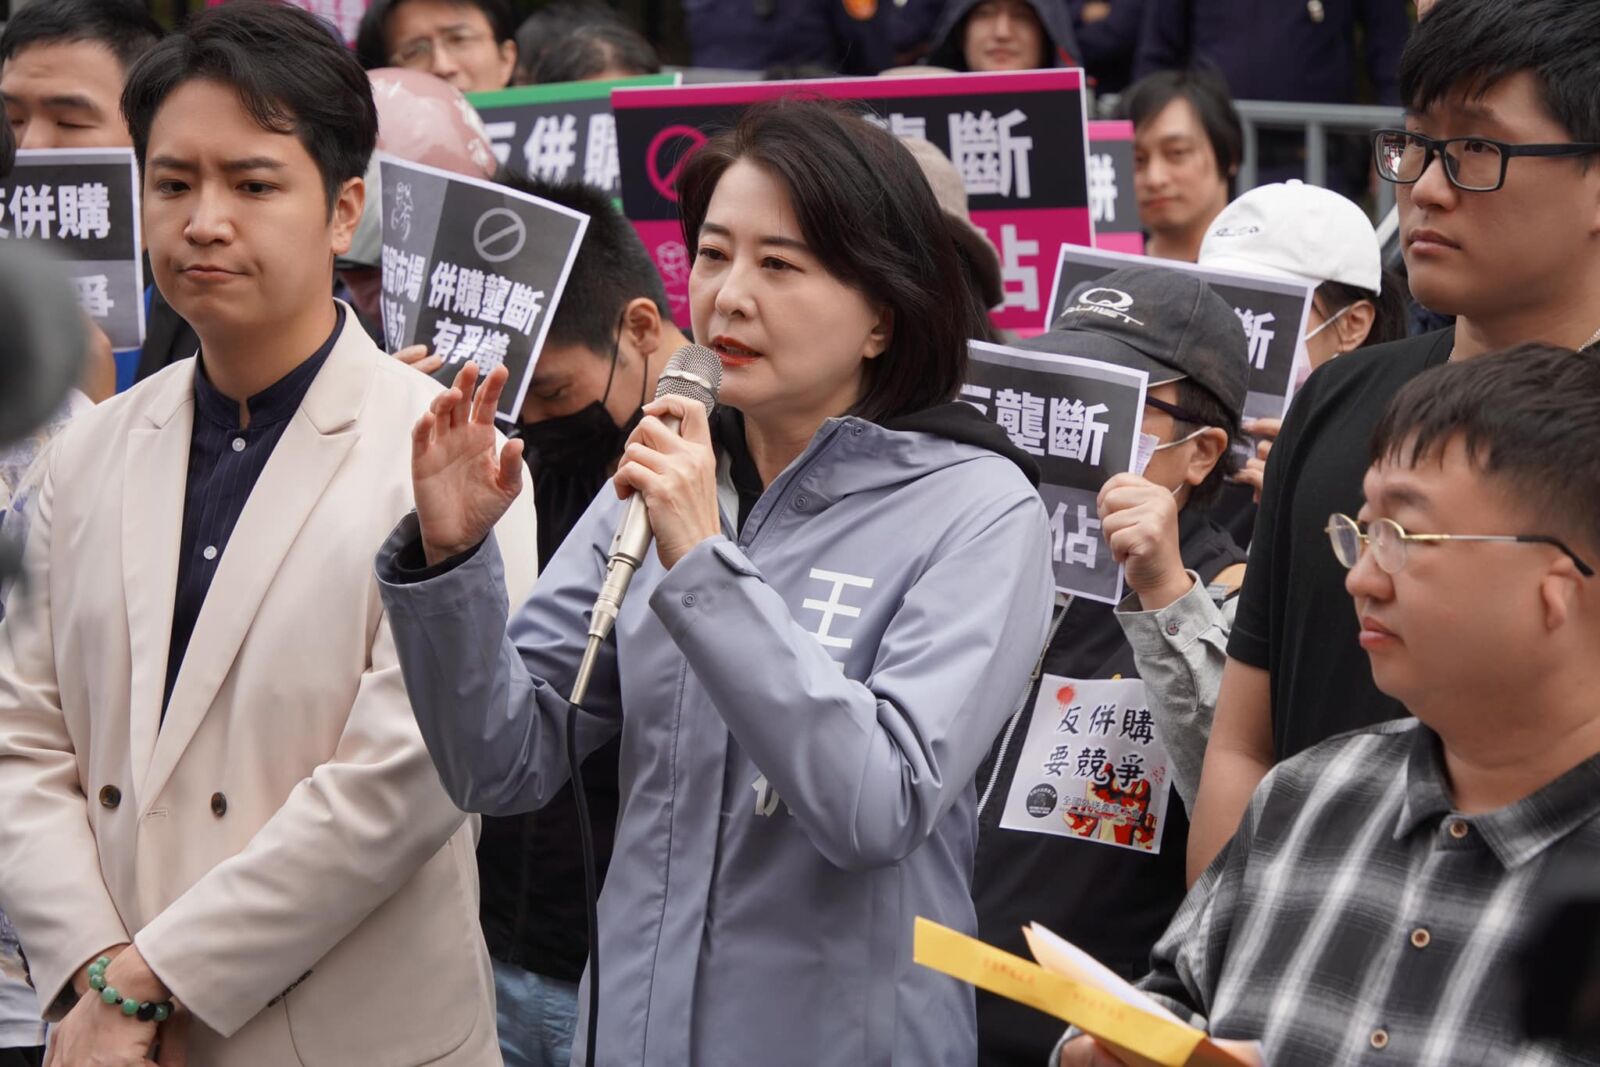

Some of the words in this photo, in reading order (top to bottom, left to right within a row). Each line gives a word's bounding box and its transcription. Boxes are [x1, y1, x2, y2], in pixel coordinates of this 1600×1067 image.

[0, 183, 110, 240] 併購
[428, 261, 545, 336] 併購壟斷
[1051, 503, 1102, 569] 佔
[802, 567, 875, 649] 王
[1057, 704, 1156, 745] 反併購
[1044, 745, 1145, 788] 要競爭
